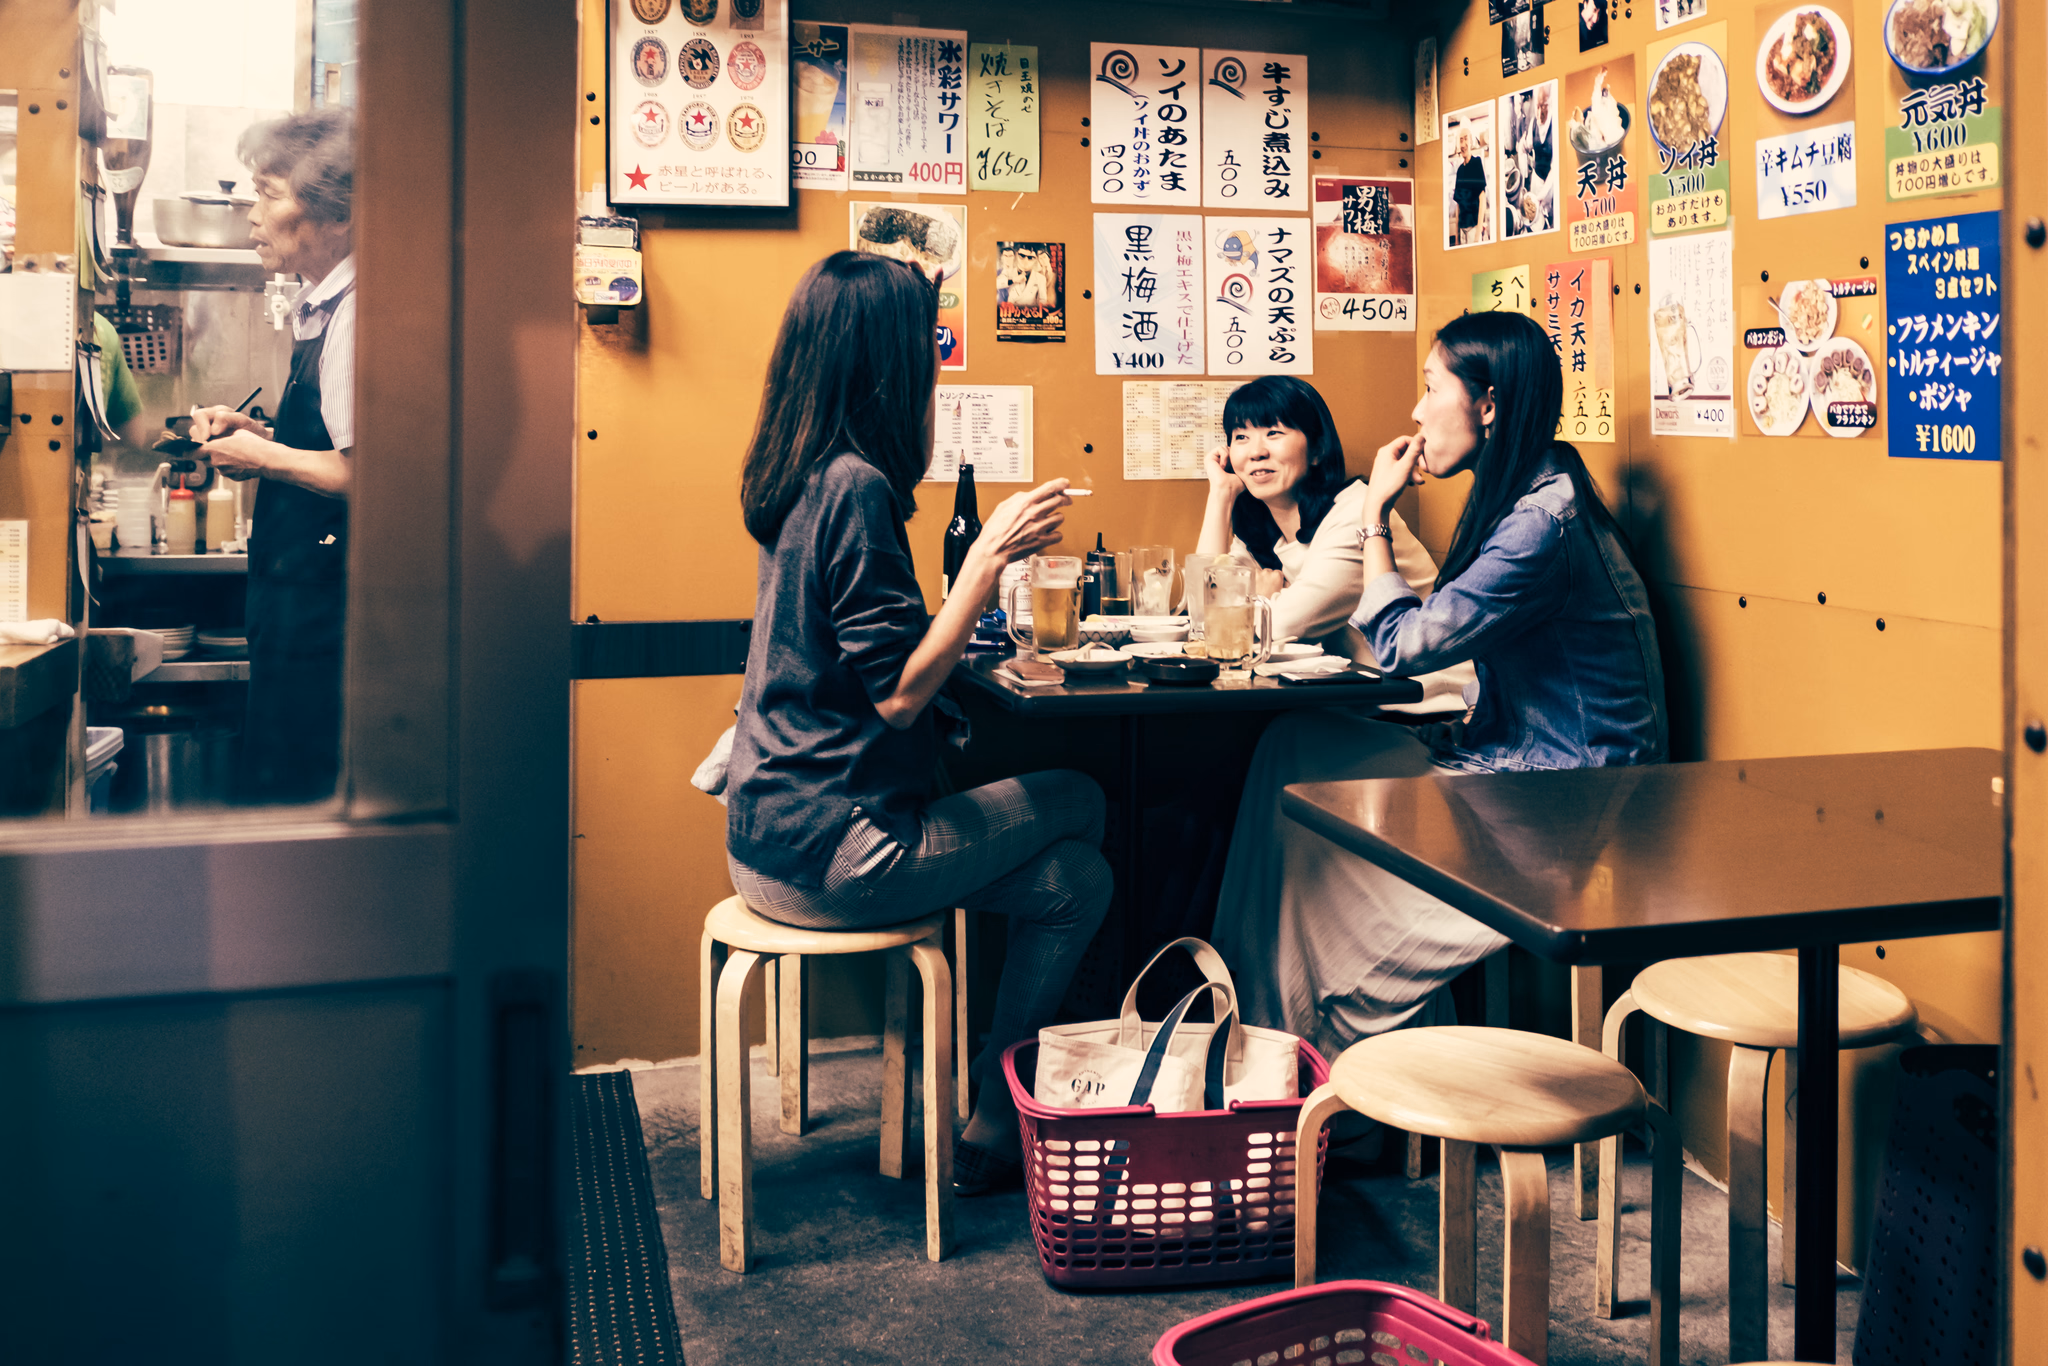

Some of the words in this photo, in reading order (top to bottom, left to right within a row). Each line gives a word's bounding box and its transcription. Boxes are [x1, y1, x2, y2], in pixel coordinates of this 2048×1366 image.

[938, 39, 963, 154] 氷彩サワー
[980, 52, 1013, 138] 焼きそば
[1900, 77, 1989, 129] 元気丼
[1157, 58, 1188, 192] ソイのあたま
[1262, 62, 1291, 198] 牛すじ煮込み
[1913, 122, 1967, 154] ¥600
[1658, 136, 1719, 175] ソイ丼
[1759, 133, 1852, 177] 辛キムチ豆腐
[1895, 150, 1981, 177] 丼物の大盛りは
[658, 165, 772, 179] 赤星と呼ばれる、
[909, 162, 963, 185] 400円
[1577, 155, 1628, 199] 天丼
[1668, 173, 1706, 197] ¥500
[659, 182, 757, 195] ビールがある。
[1656, 194, 1723, 215] おかずだけも
[1780, 179, 1827, 207] ¥550
[1343, 195, 1356, 234] サワー
[1353, 186, 1378, 235] 男梅
[1583, 196, 1616, 218] ¥700
[1573, 216, 1625, 236] 丼物の大盛りは
[1121, 225, 1159, 343] 黒梅酒
[1176, 230, 1194, 365] 黒い梅エキスで仕上げた
[1268, 227, 1296, 364] ナマズの天ぷら
[1705, 239, 1715, 343] デュワーズから
[1833, 280, 1876, 297] トルティージャ
[1342, 298, 1407, 321] 450円
[1547, 271, 1563, 367] ササミ天
[1570, 268, 1587, 373] イカ天丼
[1112, 352, 1164, 369] ¥400
[940, 392, 994, 400] ドリンクメニュー
[1697, 408, 1725, 422] ¥400
[1915, 424, 1976, 454] ¥1600
[1071, 1078, 1106, 1096] GAP
